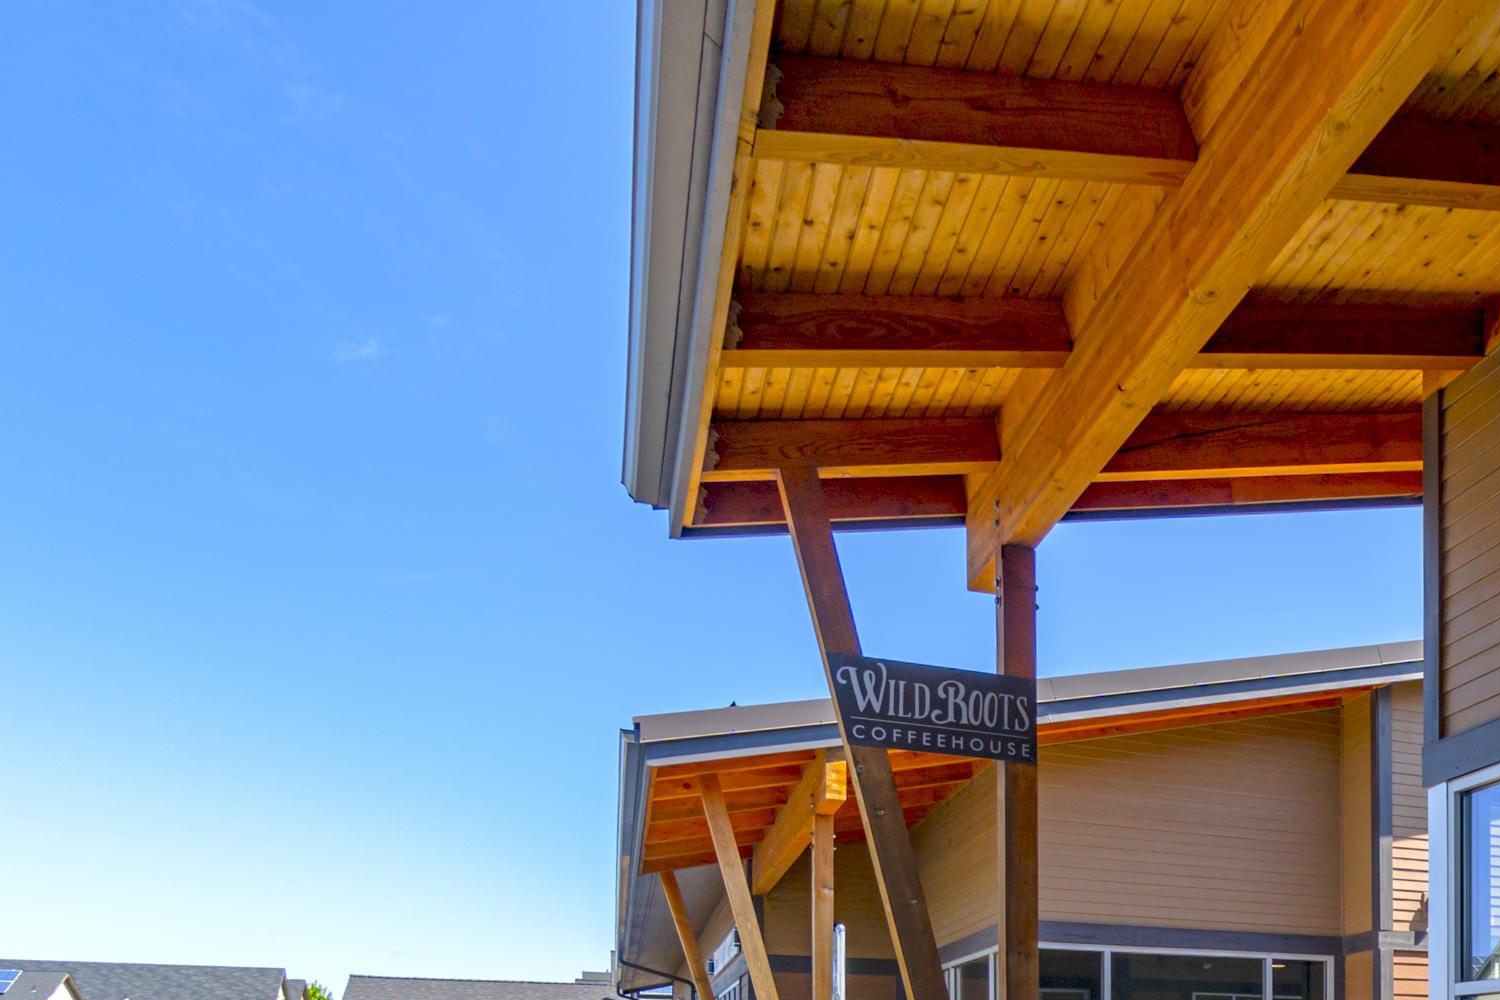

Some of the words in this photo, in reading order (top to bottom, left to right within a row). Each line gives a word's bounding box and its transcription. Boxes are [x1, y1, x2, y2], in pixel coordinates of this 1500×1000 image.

[836, 663, 930, 719] WILD
[930, 680, 1030, 732] ROOTS
[852, 724, 1031, 758] COFFEEHOUSE
